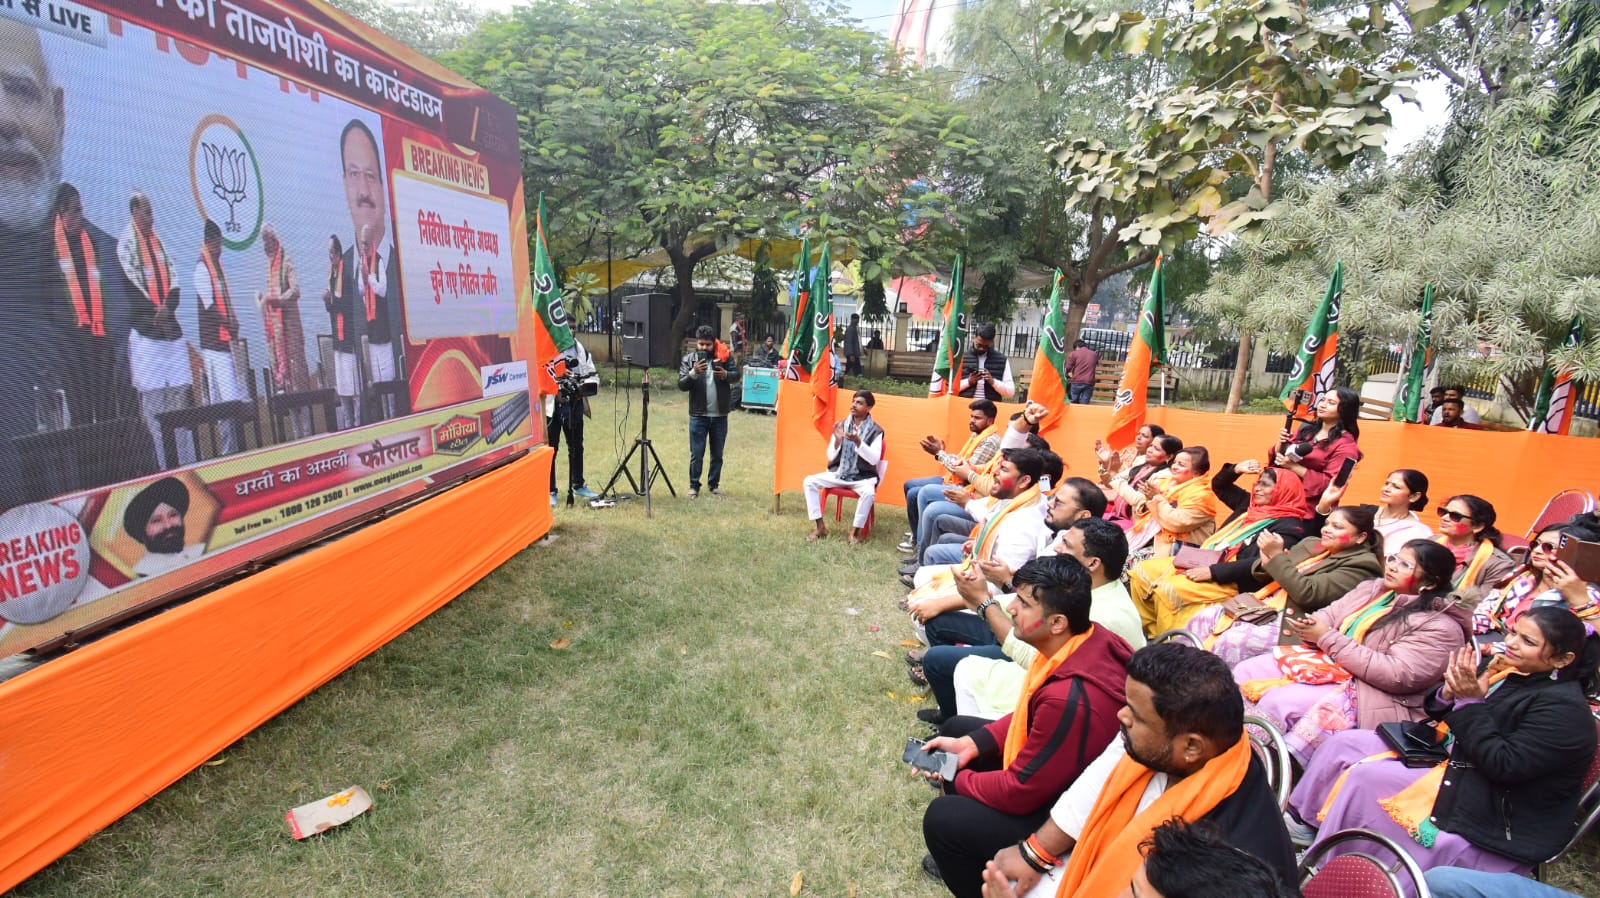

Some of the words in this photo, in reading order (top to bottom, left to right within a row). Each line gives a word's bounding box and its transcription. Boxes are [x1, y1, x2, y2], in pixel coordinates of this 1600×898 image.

[49, 4, 92, 34] LIVE
[221, 0, 328, 74] ताजपोशी
[333, 50, 360, 88] का
[363, 64, 443, 122] काउंटडाउन
[411, 144, 460, 183] BREAKING
[461, 160, 485, 190] NEWS
[452, 219, 476, 256] राष्ट्रीय
[477, 230, 499, 258] अध्यक्ष
[430, 261, 444, 304] चुने
[445, 271, 458, 299] गए
[459, 262, 480, 295] नितिन
[480, 266, 498, 295] नबीन
[484, 371, 508, 389] JSW
[235, 470, 275, 495] धरती
[278, 467, 301, 483] का
[306, 450, 349, 475] असली
[357, 437, 420, 469] फौलाद
[0, 522, 81, 566] REAKING
[0, 548, 80, 603] NEWS
